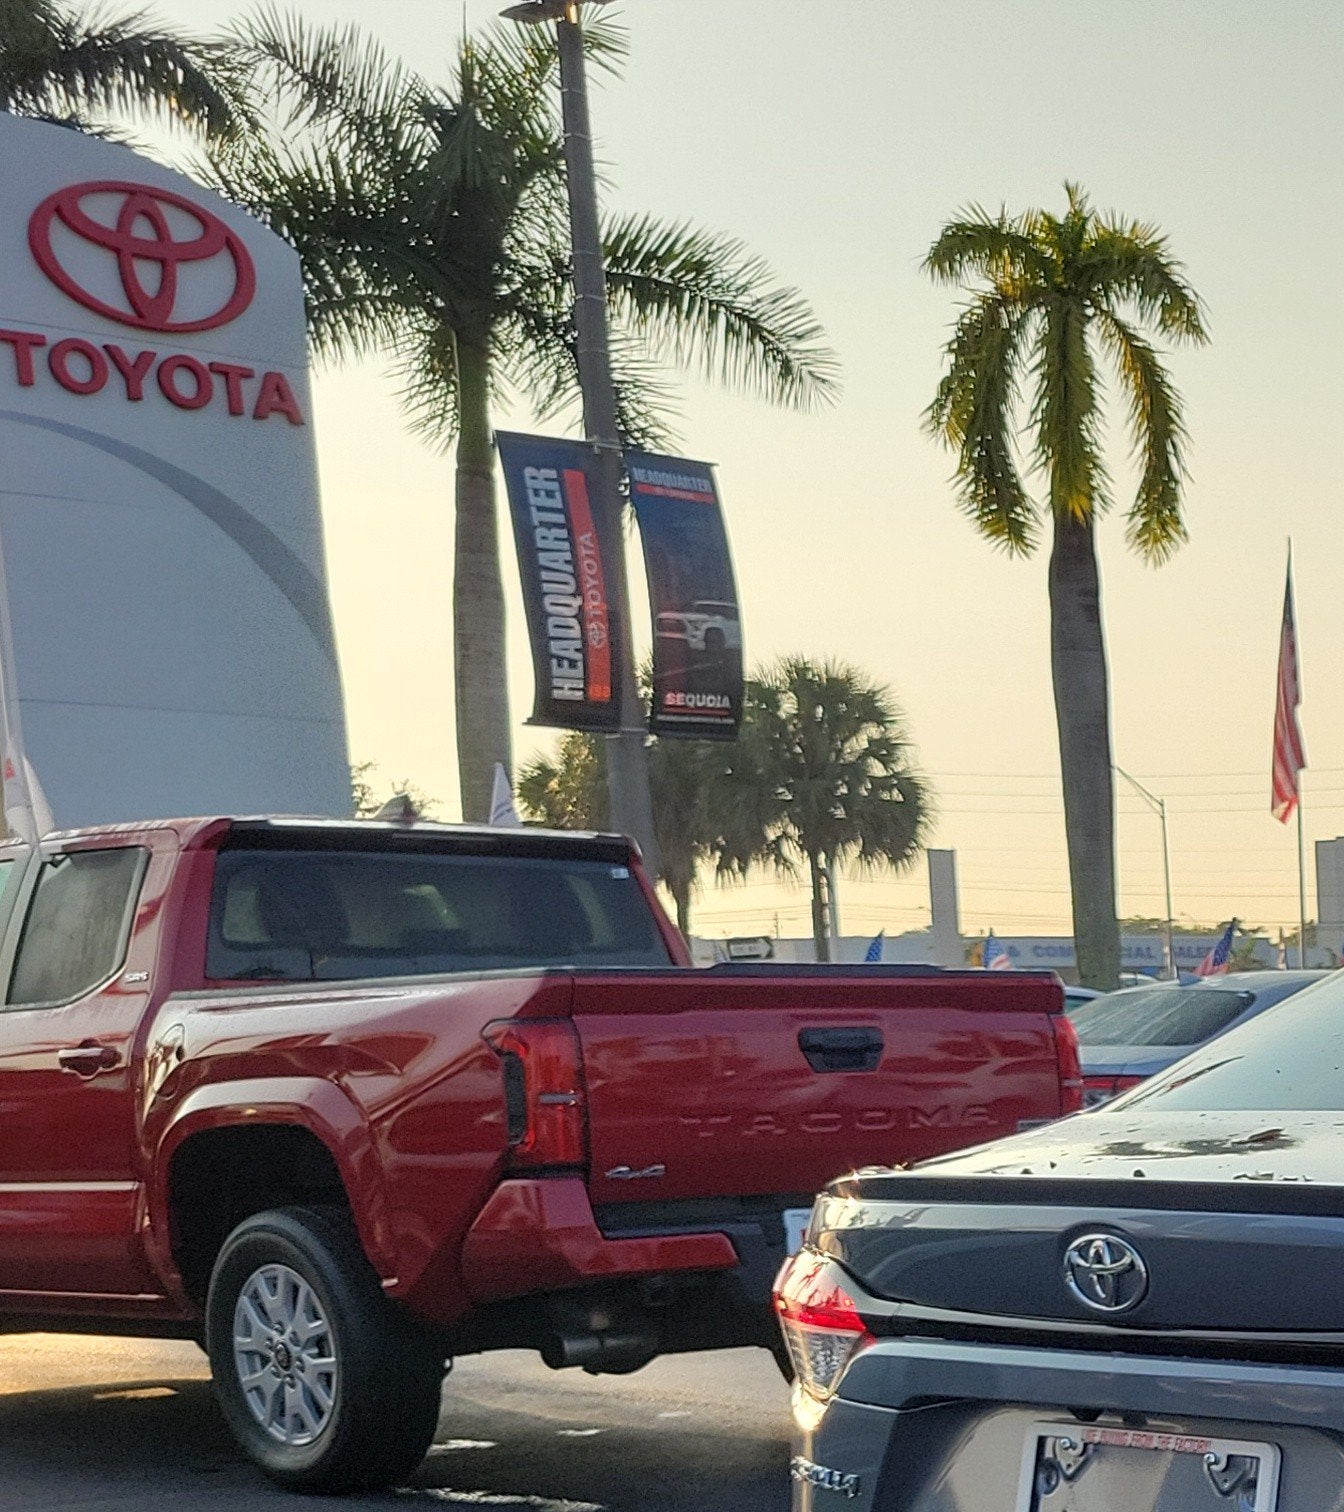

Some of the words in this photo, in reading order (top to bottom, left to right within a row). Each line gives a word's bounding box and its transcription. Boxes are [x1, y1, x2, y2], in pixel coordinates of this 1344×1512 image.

[0, 329, 304, 426] TOYOTA
[523, 465, 586, 701] HEADQUARTER
[579, 531, 609, 614] TOYOTA
[664, 691, 731, 708] SEQUOIA
[679, 1103, 998, 1138] TACOMA
